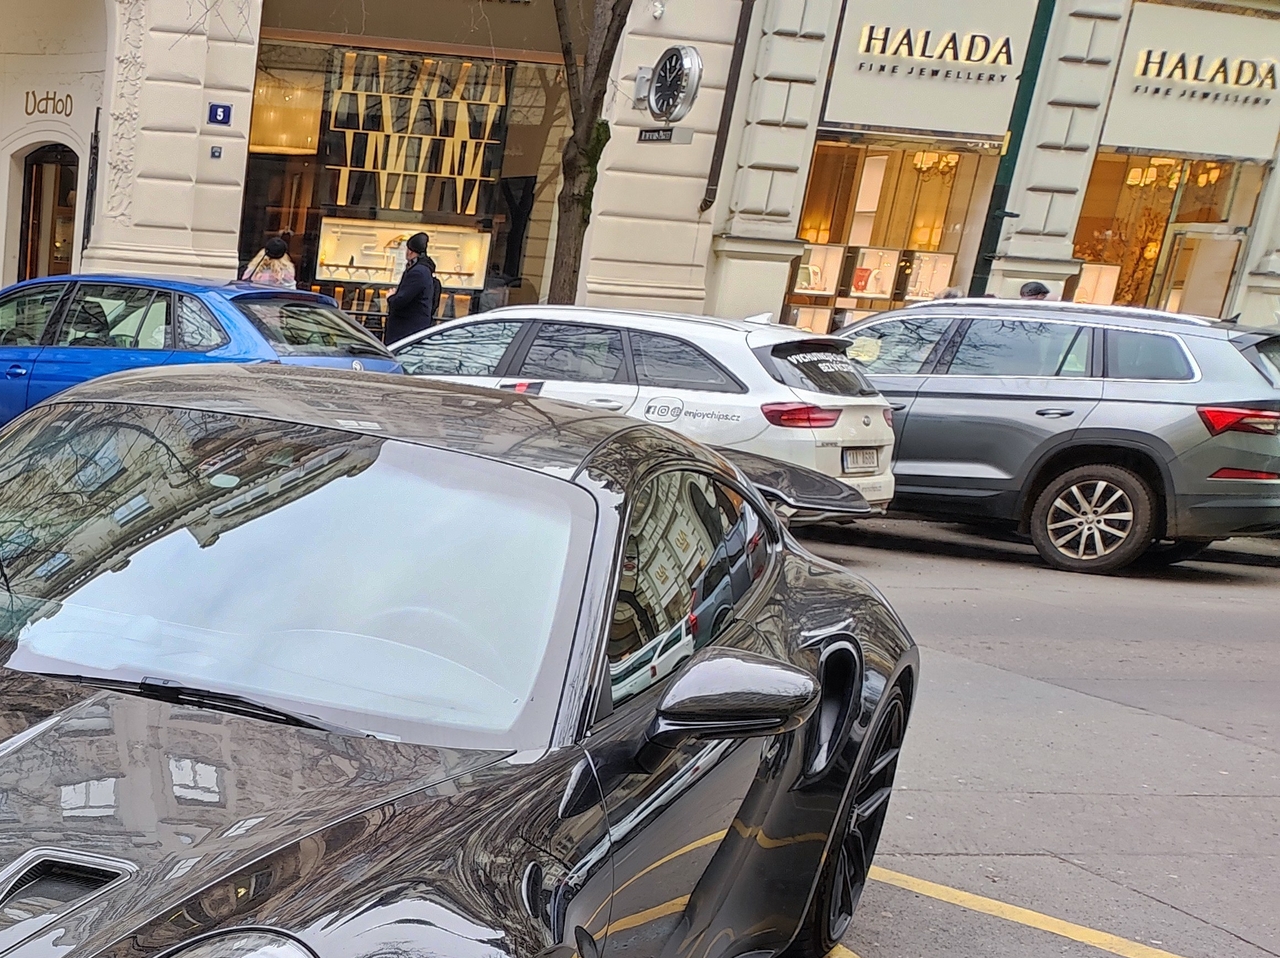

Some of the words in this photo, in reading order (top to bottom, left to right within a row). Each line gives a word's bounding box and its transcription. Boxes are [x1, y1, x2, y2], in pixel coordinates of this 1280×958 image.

[864, 26, 1013, 65] HALADA
[858, 62, 899, 75] FINE
[907, 65, 1008, 83] JEWELLERY
[1141, 50, 1278, 90] HALADA
[1133, 85, 1173, 98] FINE
[1180, 88, 1273, 106] JEWELLERY
[216, 107, 224, 121] 5
[684, 409, 741, 422] enjoychips.cz
